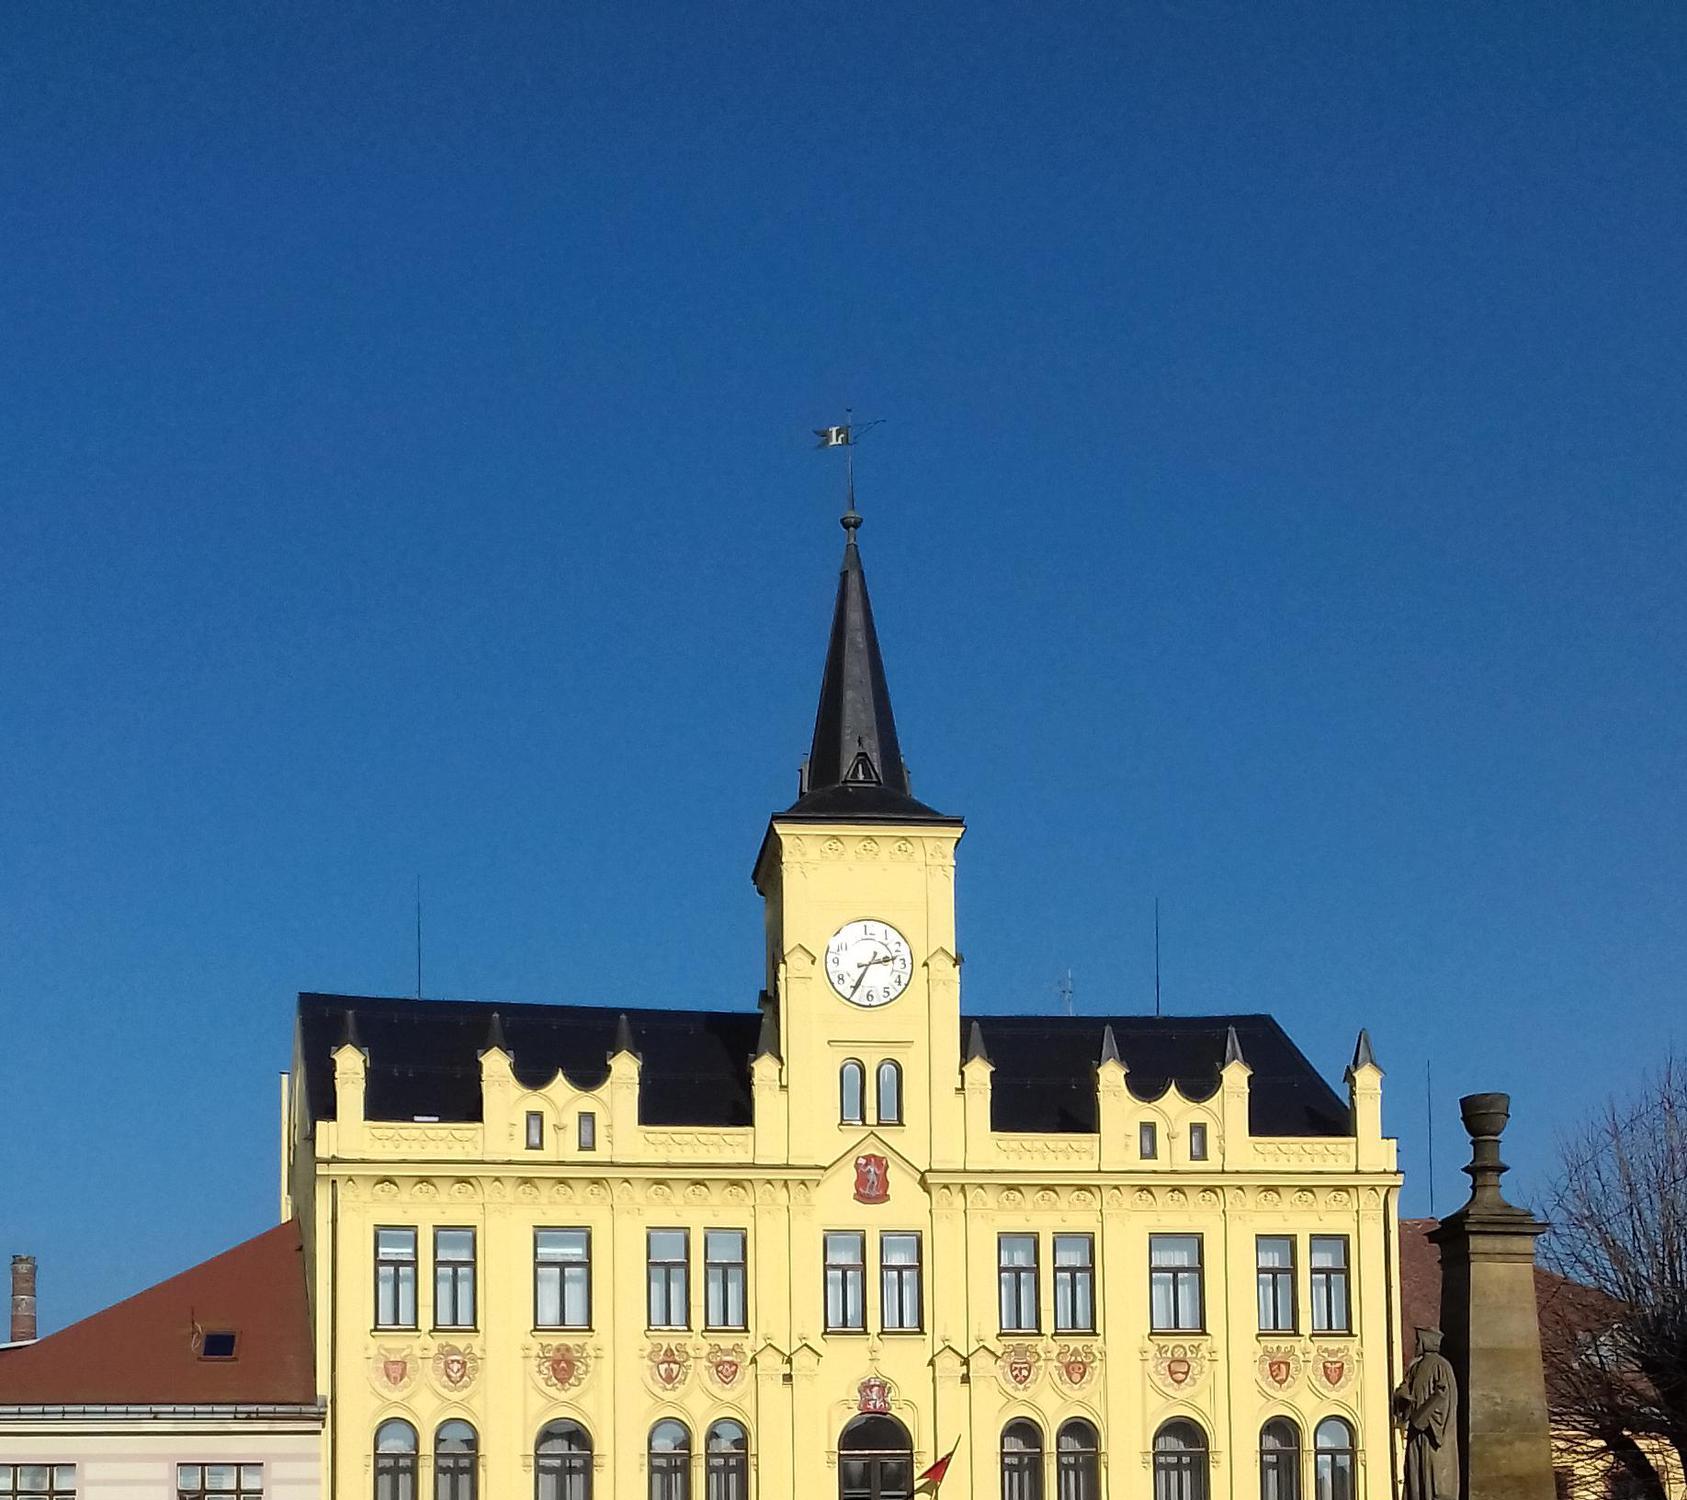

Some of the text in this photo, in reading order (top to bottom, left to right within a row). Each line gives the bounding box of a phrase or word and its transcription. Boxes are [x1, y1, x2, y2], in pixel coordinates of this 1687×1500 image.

[895, 941, 901, 953] 2
[832, 957, 840, 967] 9
[899, 958, 907, 970] 3
[837, 973, 845, 985] 8
[894, 975, 902, 986] 4
[866, 990, 874, 1002] 6
[883, 987, 890, 998] 5
